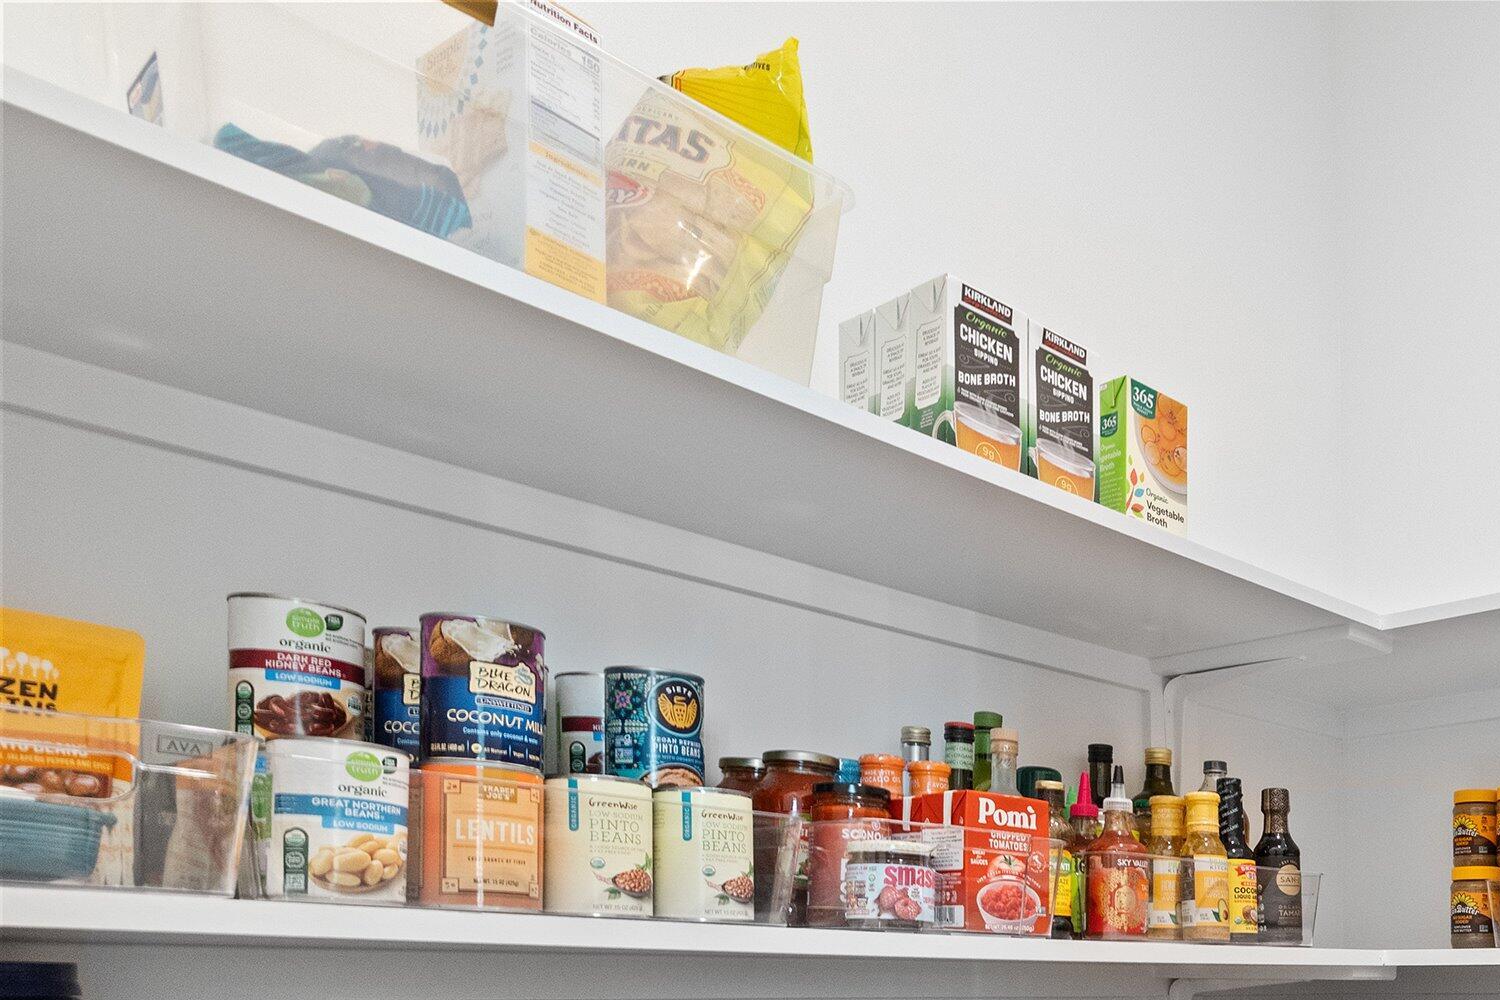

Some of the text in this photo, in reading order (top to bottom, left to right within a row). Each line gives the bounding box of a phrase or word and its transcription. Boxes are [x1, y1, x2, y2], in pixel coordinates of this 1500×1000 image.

[530, 0, 599, 44] Nutrition Facts
[964, 287, 1011, 318] KIRKLAND
[966, 312, 1007, 338] Organic
[960, 323, 1013, 363] CHICKEN
[1045, 329, 1085, 358] KIRKLAND
[974, 349, 999, 366] SIPPING
[1045, 354, 1081, 377] Organic
[958, 371, 1016, 387] BONE BROTH
[1040, 364, 1087, 400] CHICKEN
[1133, 387, 1154, 409] 365
[1039, 410, 1090, 424] BONE BROTH
[1101, 415, 1117, 430] 365
[1146, 488, 1169, 505] Organic
[1146, 500, 1185, 524] Vegetable
[1146, 512, 1168, 528] Broth
[279, 637, 331, 653] organic
[276, 652, 332, 668] DARK RED
[265, 659, 342, 678] KIDNEY BEANS
[479, 667, 512, 681] BLUE
[477, 678, 531, 697] DRAGON
[446, 708, 524, 729] COCONUT
[655, 742, 679, 755] PINTO
[338, 783, 388, 797] organic
[311, 797, 401, 815] GREAT NORTHERN
[588, 797, 638, 810] GreenWise
[344, 807, 381, 819] BEANS
[701, 809, 744, 821] GreenWise
[333, 820, 353, 830] LOW
[456, 817, 535, 846] LENTILS
[590, 819, 640, 832] PINTO
[590, 831, 642, 845] BEANS
[702, 830, 745, 842] PINTO
[702, 841, 747, 853] BEANS
[989, 839, 1028, 851] TOMATOES
[1117, 858, 1131, 867] SKY
